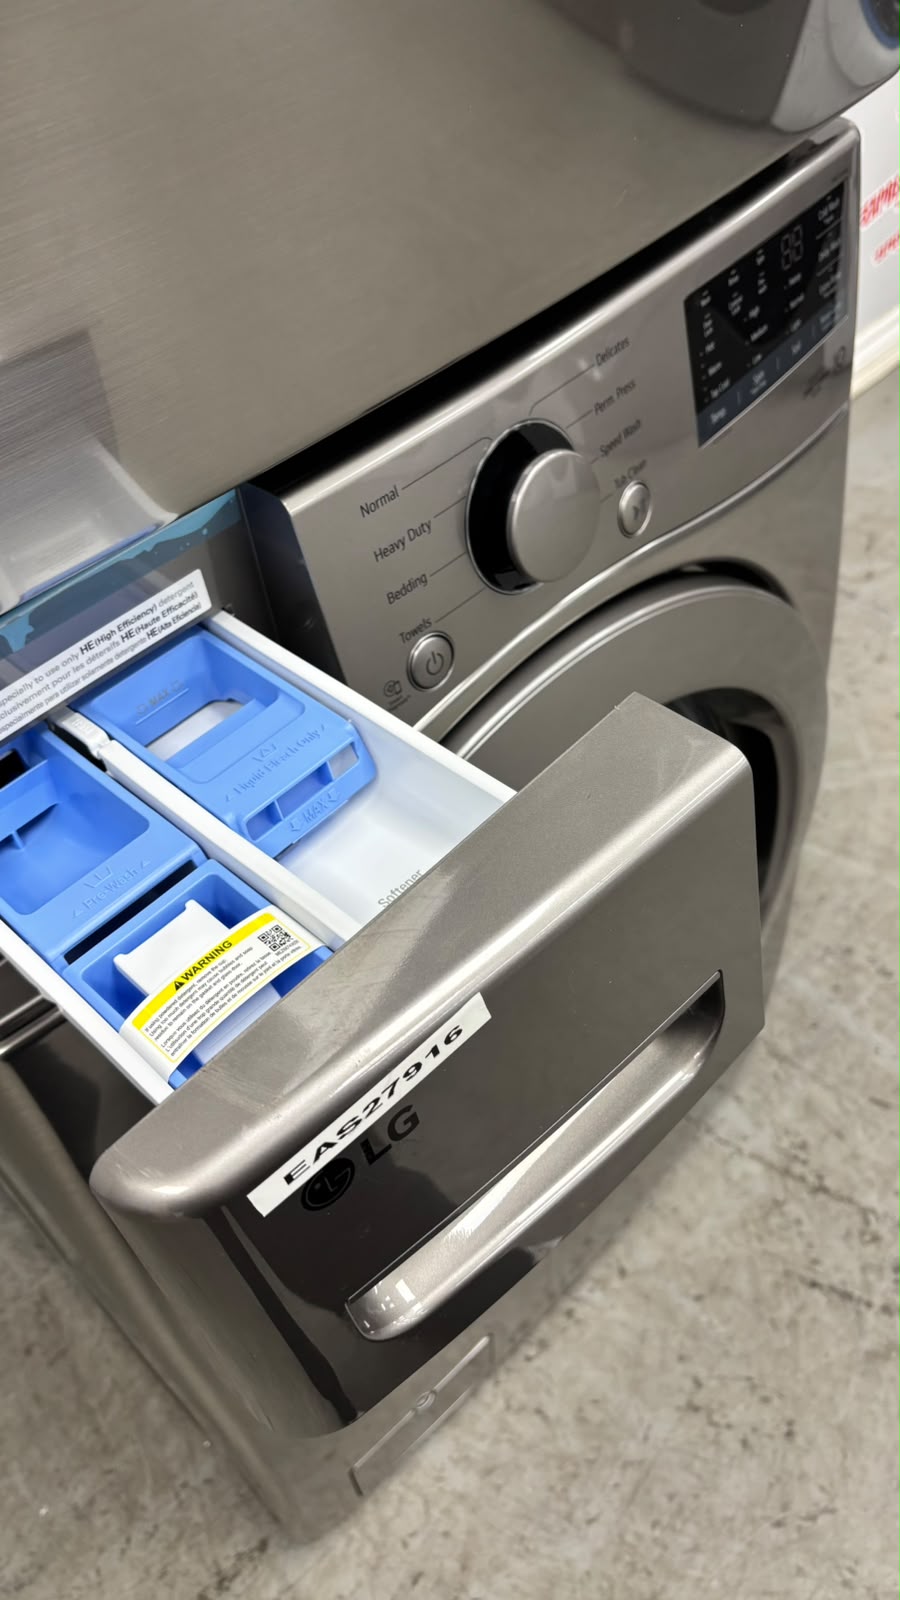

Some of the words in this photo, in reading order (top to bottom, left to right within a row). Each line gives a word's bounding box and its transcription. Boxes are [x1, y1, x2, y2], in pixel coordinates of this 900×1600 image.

[595, 337, 630, 366] Delicates
[615, 379, 636, 399] Press
[600, 432, 622, 457] Speed
[622, 418, 641, 439] Wash
[359, 484, 400, 518] Normal
[373, 536, 406, 562] Heavy
[407, 520, 432, 542] Duty
[386, 573, 428, 605] Bedding
[33, 675, 44, 684] to
[44, 665, 60, 677] use
[60, 652, 79, 667] only
[117, 604, 157, 632] Efficiency)
[158, 581, 194, 607] detergent
[399, 617, 432, 644] Towels
[0, 684, 51, 720] clusivement
[51, 670, 71, 687] pour
[72, 663, 85, 673] les
[267, 744, 299, 774] Bleach
[296, 726, 322, 749] Only
[377, 869, 423, 909] Softener
[182, 940, 232, 981] WARNING
[158, 999, 178, 1018] powdered
[167, 1006, 180, 1018] much
[179, 990, 198, 1007] detergent
[283, 1025, 463, 1185] EAS27916
[360, 1104, 420, 1165] LG
